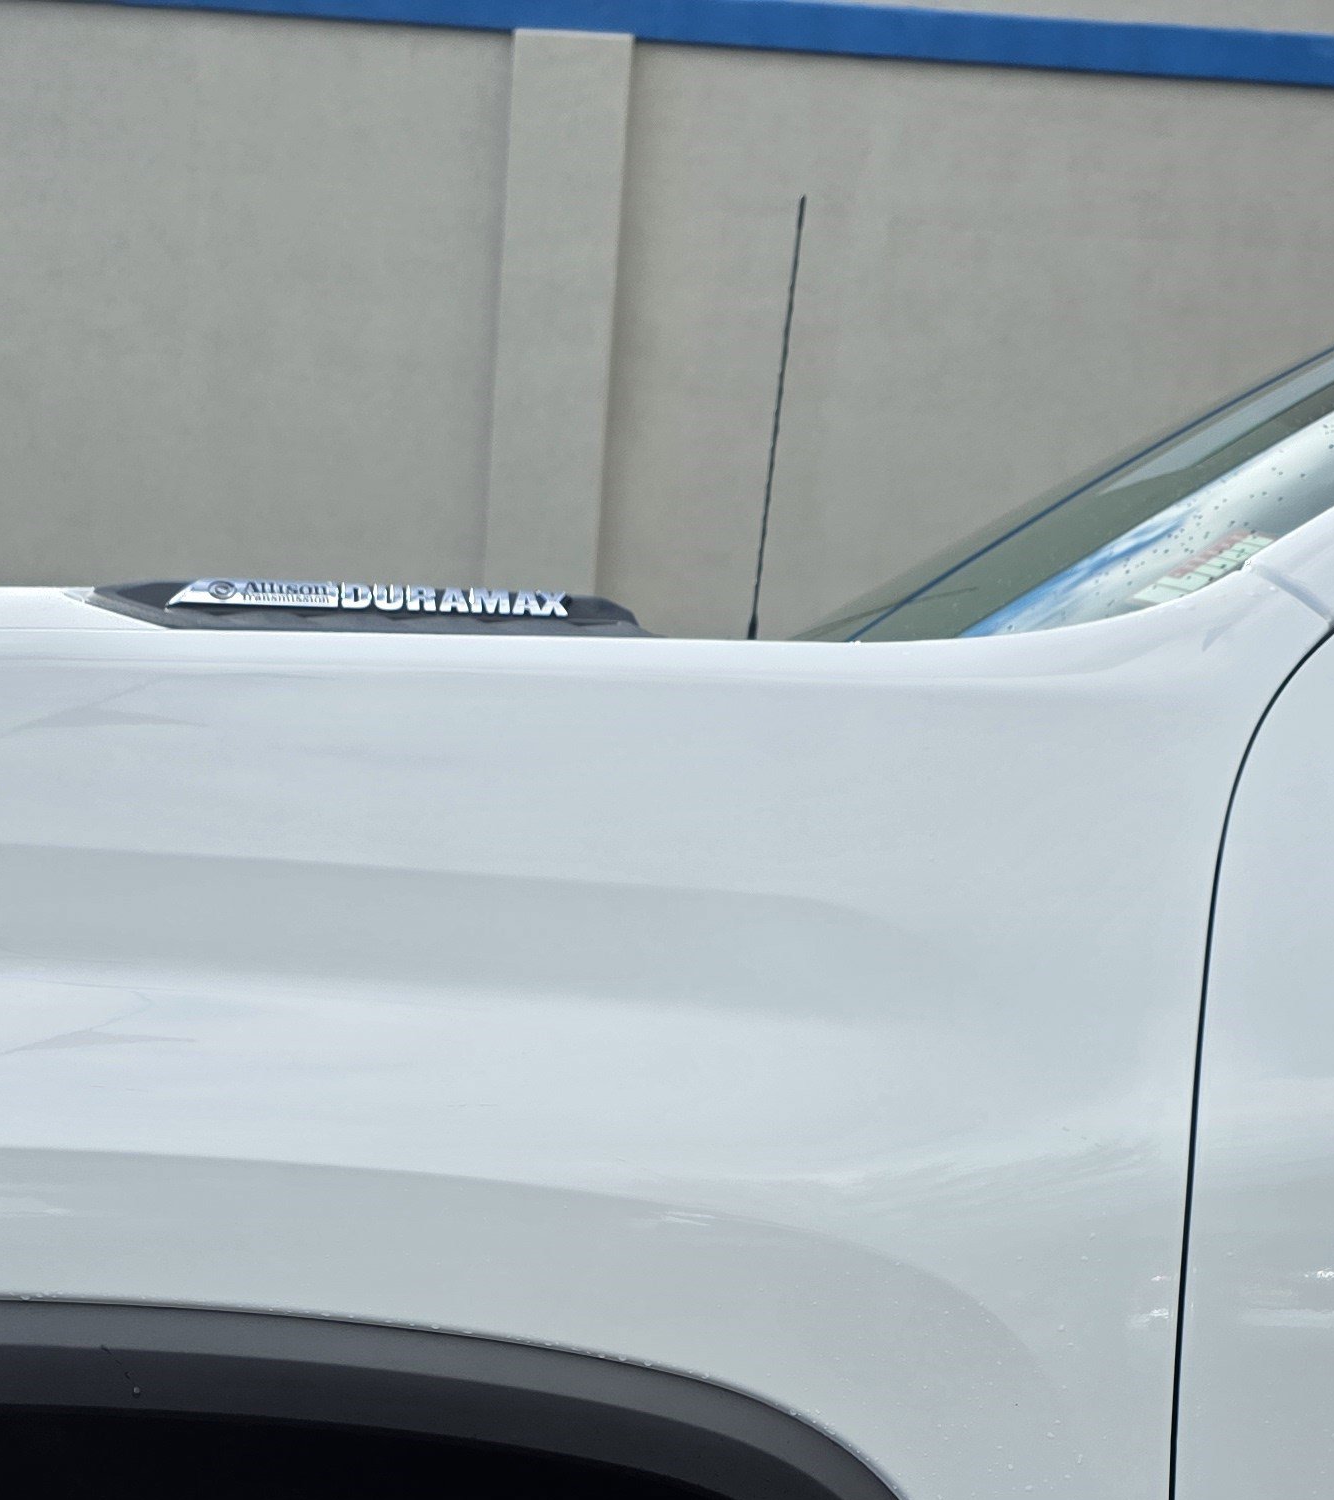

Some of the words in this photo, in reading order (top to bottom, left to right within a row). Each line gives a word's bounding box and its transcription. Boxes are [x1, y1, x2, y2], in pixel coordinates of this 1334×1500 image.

[244, 581, 327, 596] Allison
[242, 593, 330, 604] Transmission
[340, 581, 569, 617] DURAMAX
